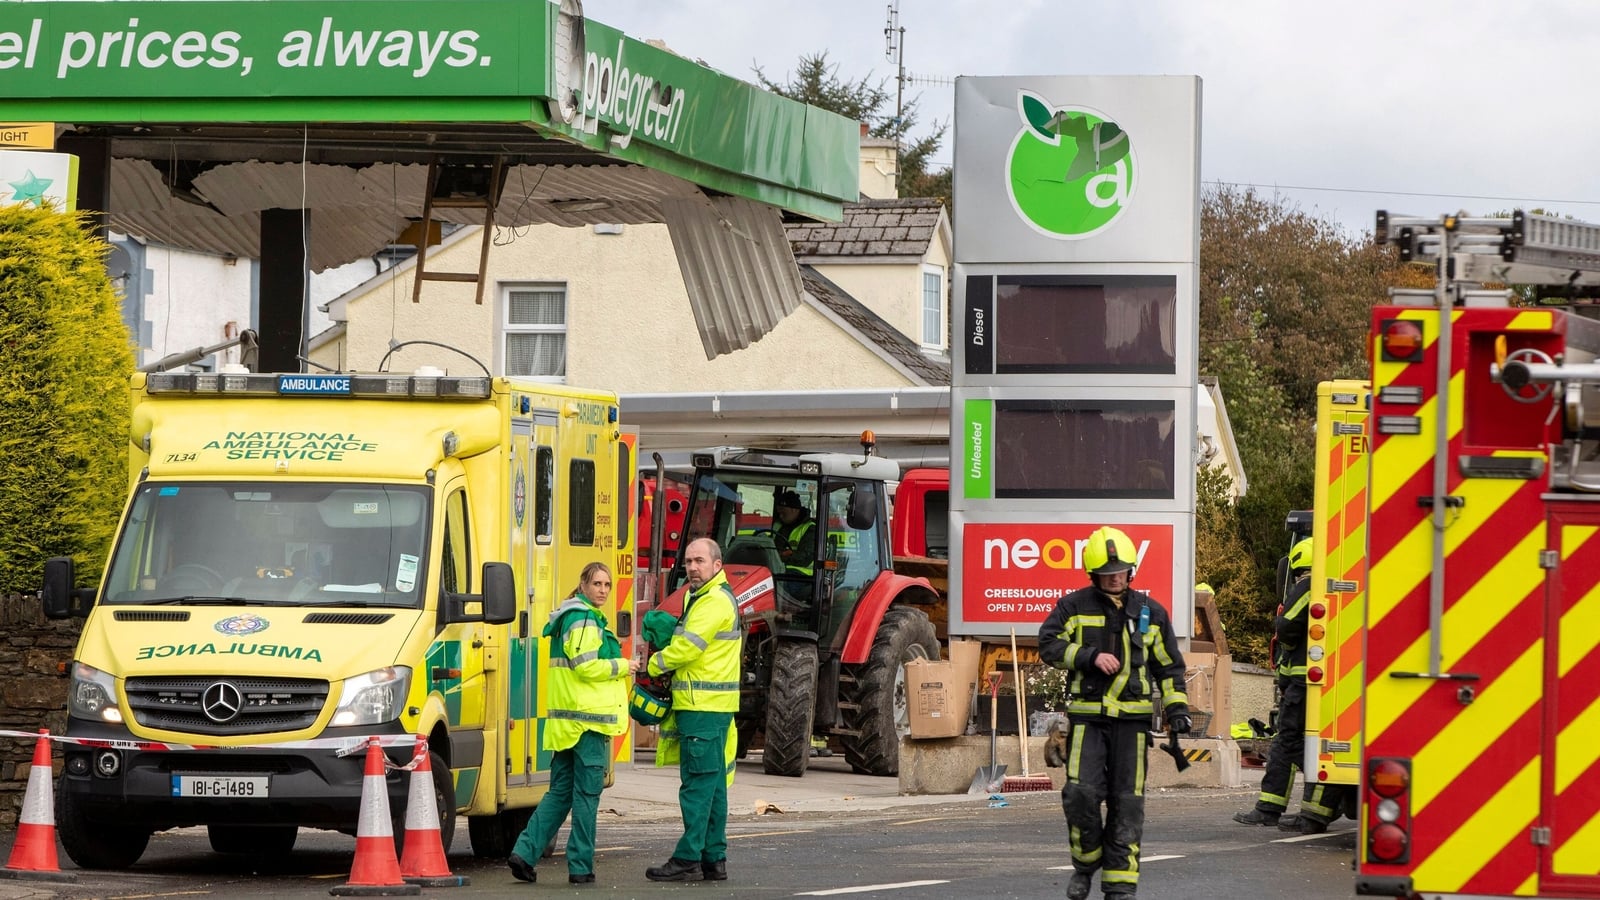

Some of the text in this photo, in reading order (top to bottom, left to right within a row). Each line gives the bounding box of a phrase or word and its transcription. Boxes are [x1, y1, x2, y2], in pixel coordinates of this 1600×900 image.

[57, 17, 255, 80] prices,
[277, 17, 493, 78] always.
[0, 131, 29, 141] IGHT
[973, 308, 984, 346] Diesel
[281, 379, 350, 391] AMBULANCE
[226, 431, 362, 442] NATIONAL
[203, 440, 379, 452] AMBULANCE
[971, 422, 982, 479] Unleaded
[166, 453, 197, 464] 7L34
[226, 450, 345, 461] SERVICE
[984, 538, 1151, 573] neary
[984, 588, 1062, 598] CREESLOUGH
[987, 603, 1052, 612] OPEN 7 DAYS
[192, 781, 254, 796] 181-G-1489
